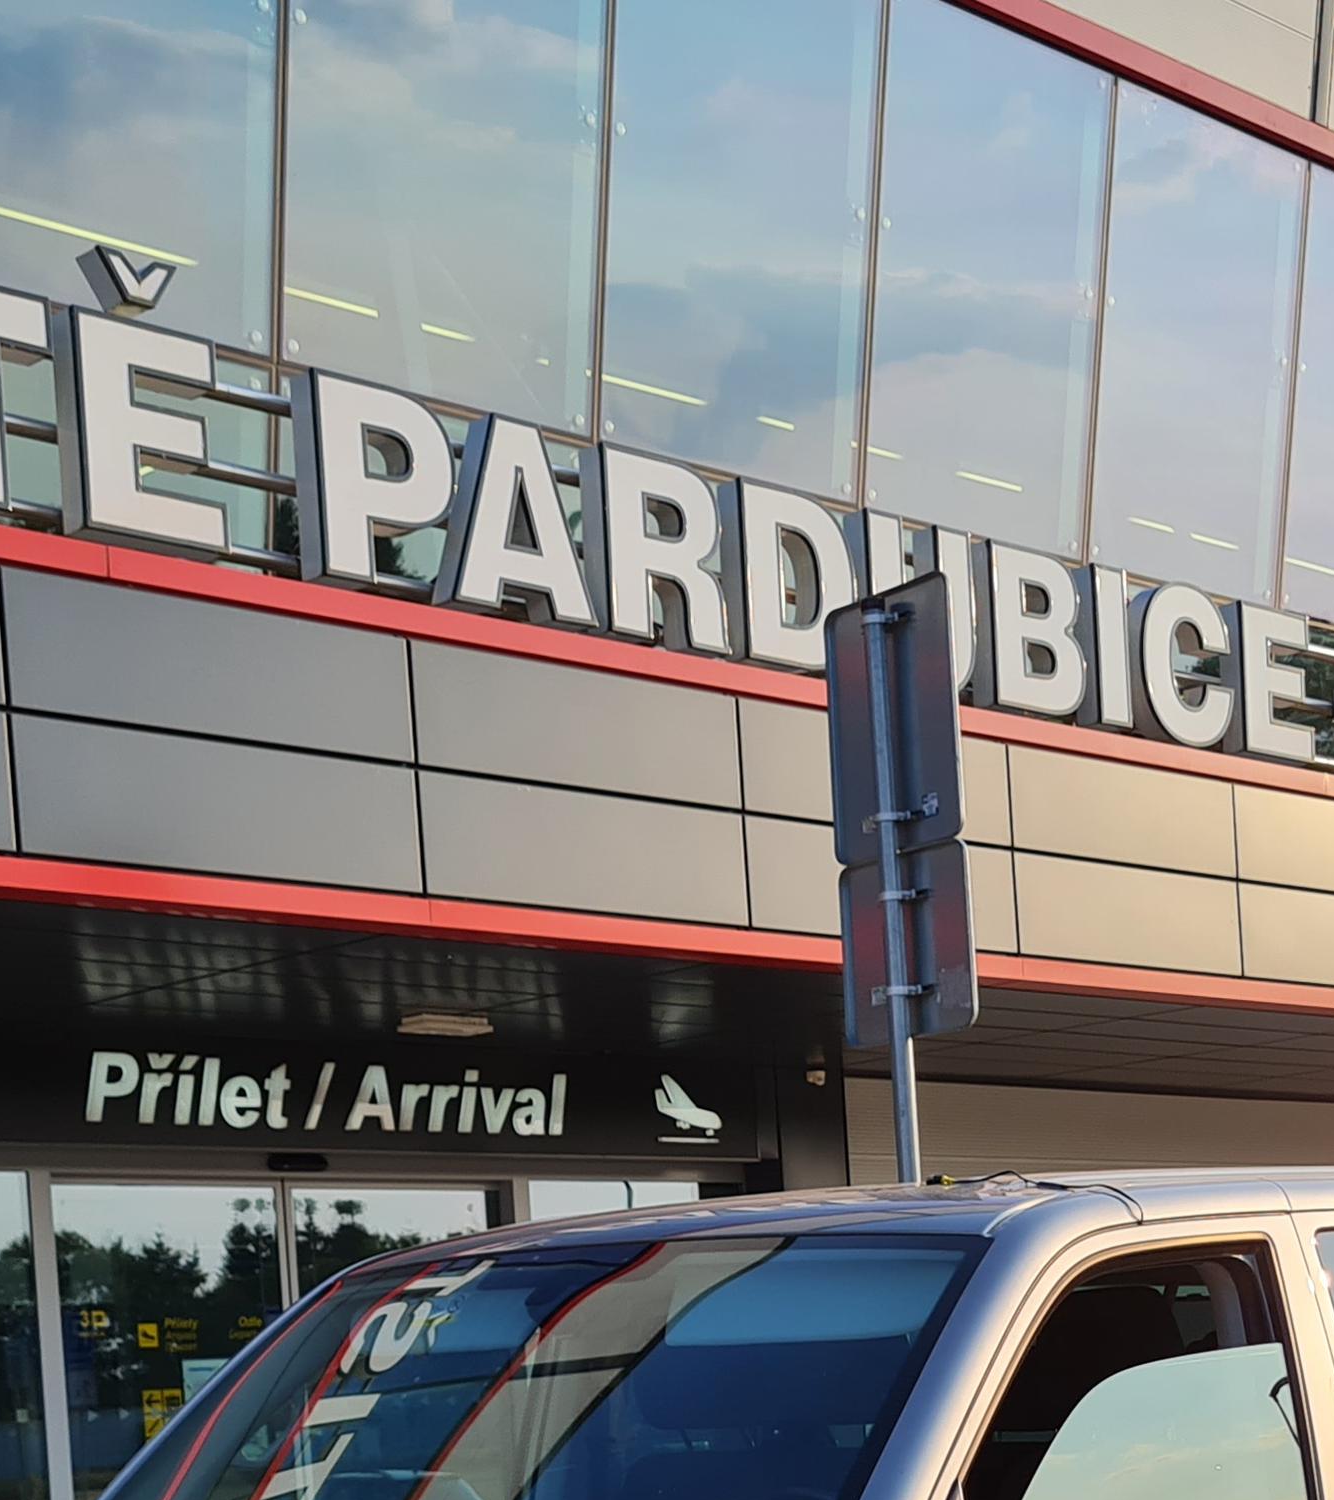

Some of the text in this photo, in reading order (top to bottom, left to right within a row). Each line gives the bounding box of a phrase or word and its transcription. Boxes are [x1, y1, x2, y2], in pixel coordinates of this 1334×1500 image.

[307, 366, 1318, 763] PARDUBICE
[84, 1050, 292, 1130] Přílet
[344, 1064, 568, 1137] Arrival
